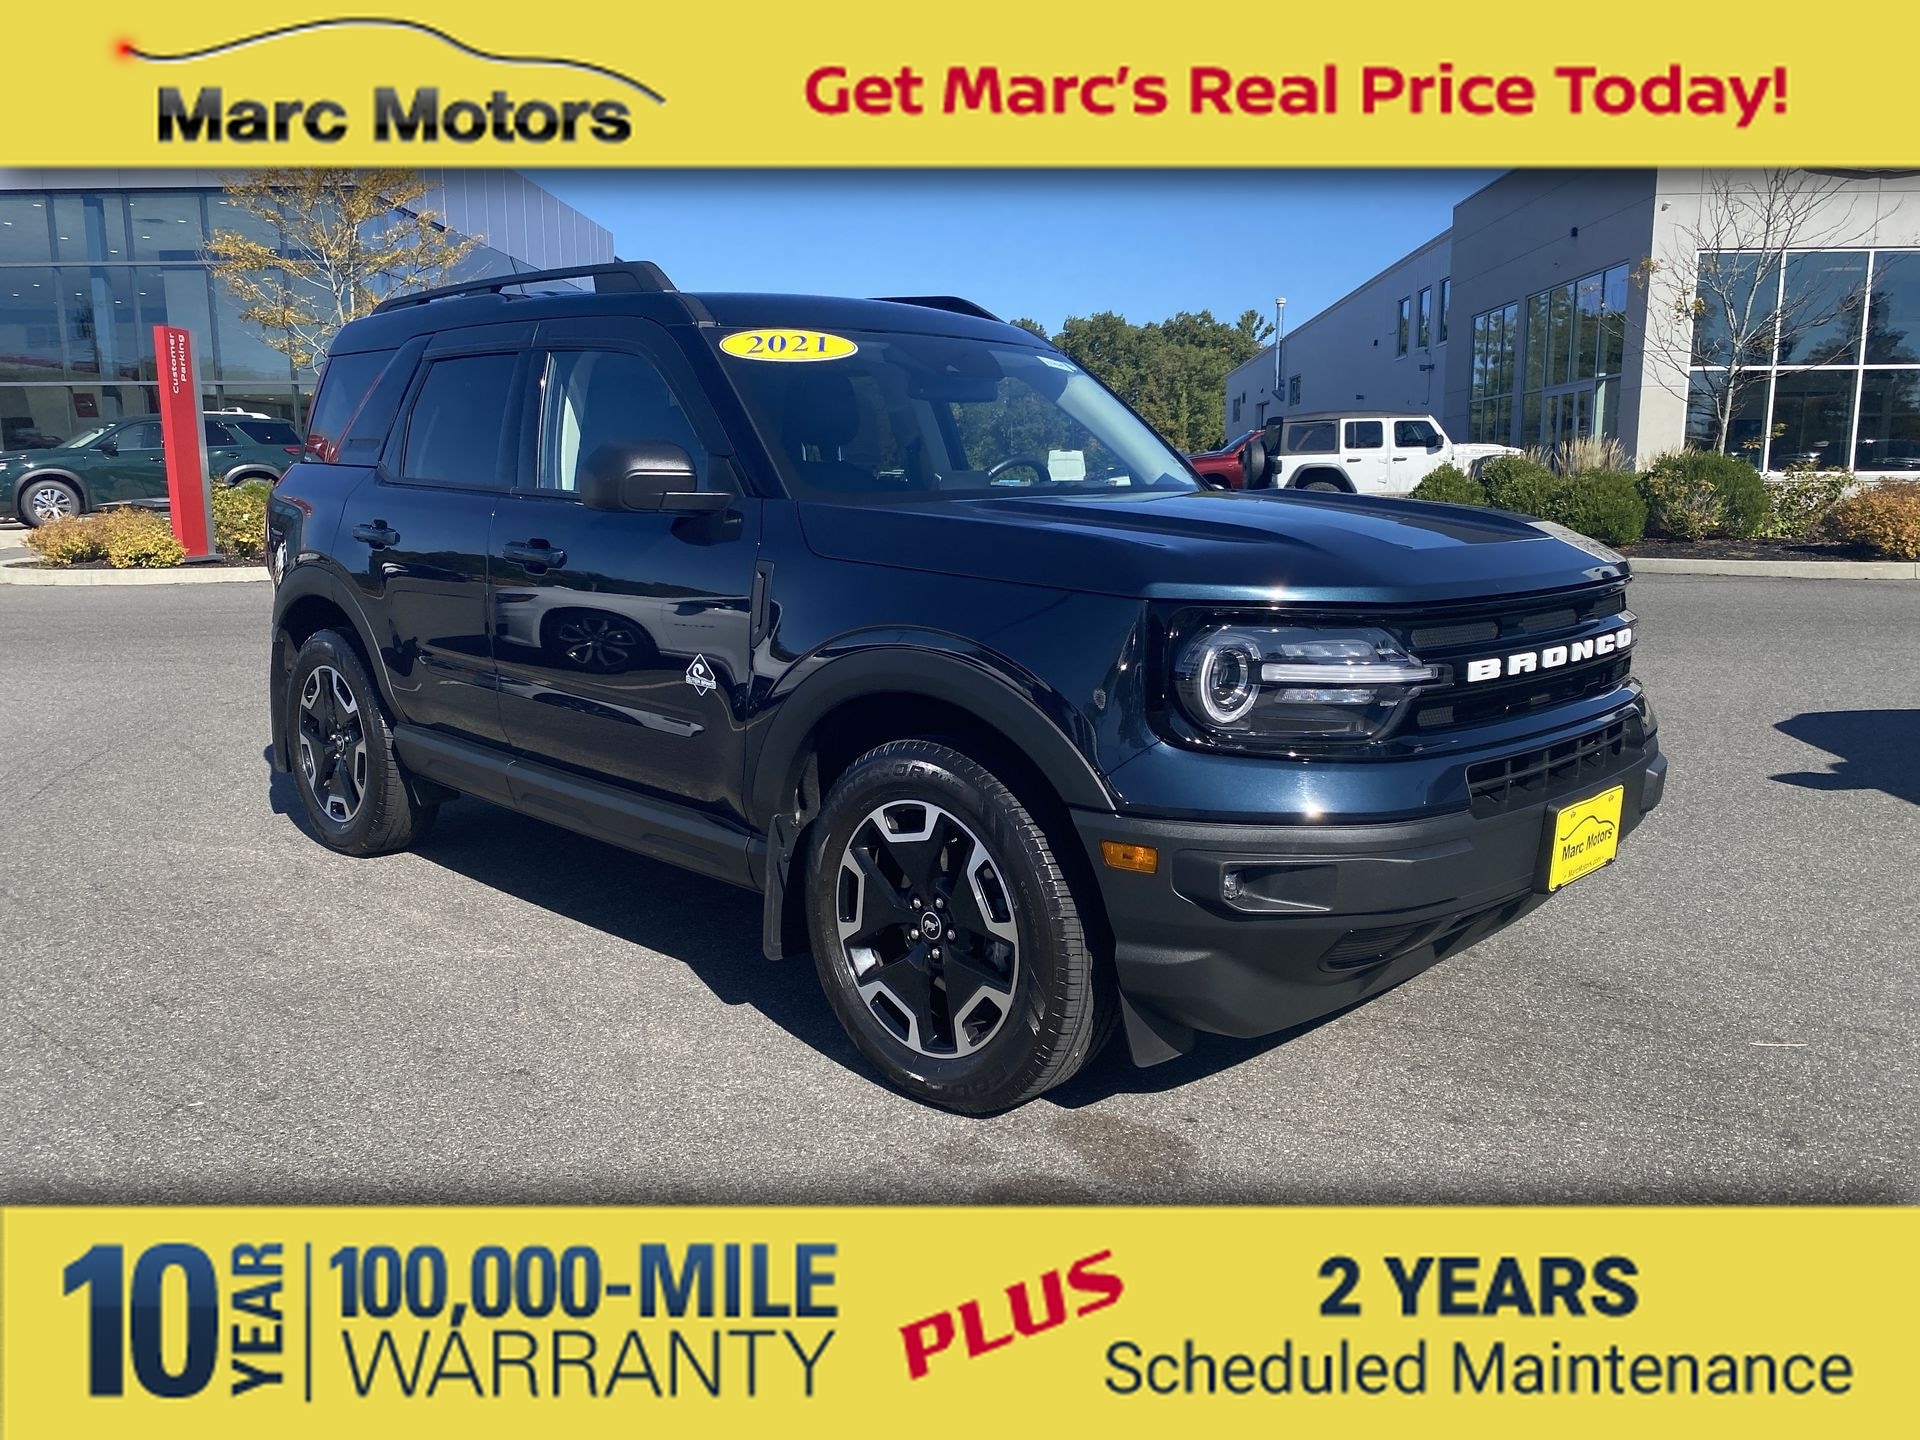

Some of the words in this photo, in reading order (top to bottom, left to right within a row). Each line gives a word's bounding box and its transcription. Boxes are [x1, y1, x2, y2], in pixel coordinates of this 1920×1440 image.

[178, 334, 187, 382] Parking
[745, 335, 828, 354] 2021
[1467, 628, 1632, 682] BRONCO
[1562, 842, 1584, 861] Marc
[1586, 828, 1613, 850] Motors
